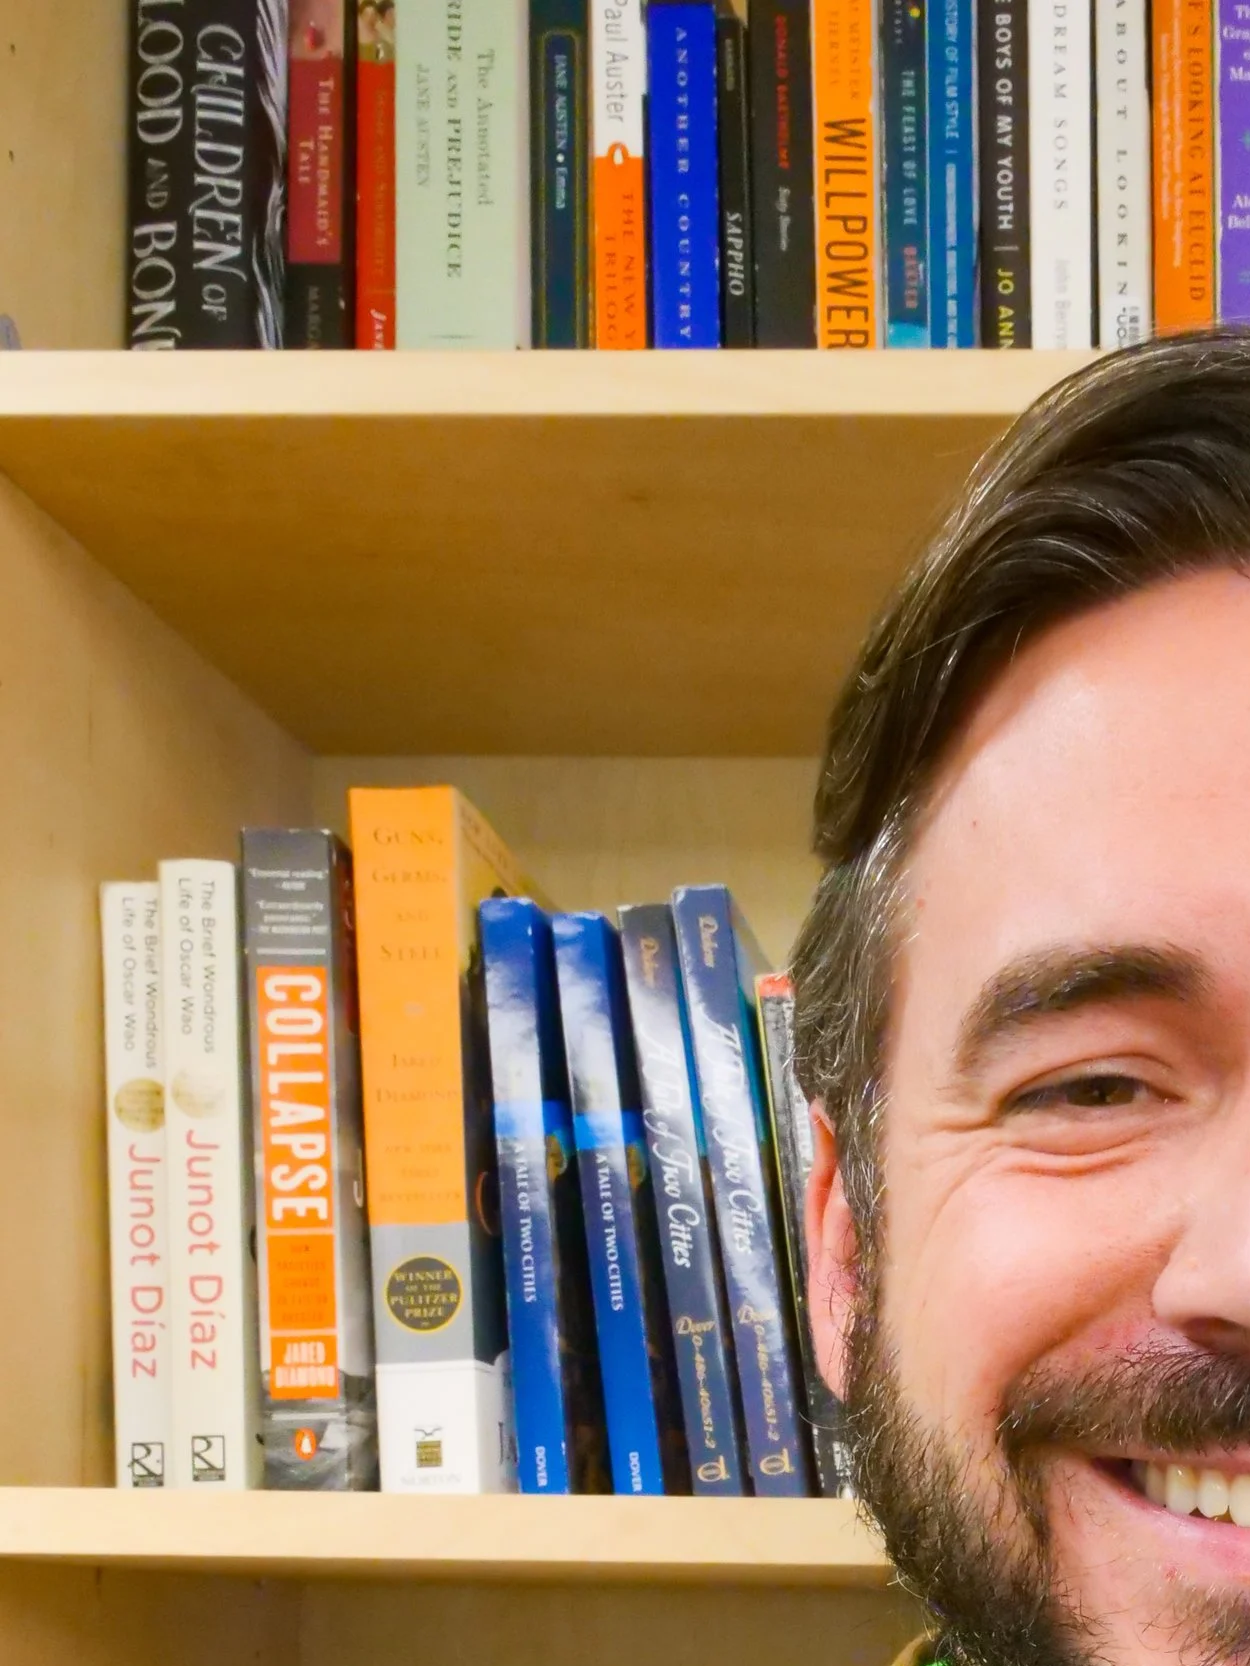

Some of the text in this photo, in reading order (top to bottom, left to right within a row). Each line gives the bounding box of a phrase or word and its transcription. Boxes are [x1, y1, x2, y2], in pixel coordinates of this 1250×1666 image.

[415, 62, 431, 190] JANE AUSTEN
[446, 74, 460, 110] AND
[476, 49, 496, 207] The Annotated
[604, 50, 629, 124] Auster
[994, 14, 1015, 231] BOYS OF MY YOUTH
[1052, 5, 1069, 212] DREAM SONGS
[145, 158, 169, 208] AND
[189, 24, 246, 321] CHILDREN OF
[446, 118, 462, 279] PREJUDICE
[676, 27, 692, 340] ANOTHER COUNTRY
[824, 117, 870, 350] WILLPOWER
[725, 211, 745, 297] SAPPHO
[997, 269, 1015, 296] JO
[121, 896, 138, 1052] Life of Oscar Wao
[143, 899, 161, 1069] The Brief Wondrous
[178, 877, 196, 1036] Life of Oscar Wao
[200, 880, 219, 1054] The Brief Wondrous
[263, 974, 329, 1222] COLLAPSE
[515, 1157, 530, 1191] TALE
[517, 1192, 531, 1212] OF
[519, 1215, 534, 1252] TWO
[595, 1152, 625, 1312] A TALE OF TWO CITIES
[652, 1143, 693, 1199] Two
[667, 1203, 701, 1269] Cities
[128, 1143, 166, 1379] Junot Díaz
[186, 1128, 226, 1371] Junot Díaz
[393, 1269, 453, 1282] WINNER
[522, 1254, 538, 1303] CITIES
[534, 1445, 549, 1487] DOVER
[629, 1451, 643, 1493] DOVER
